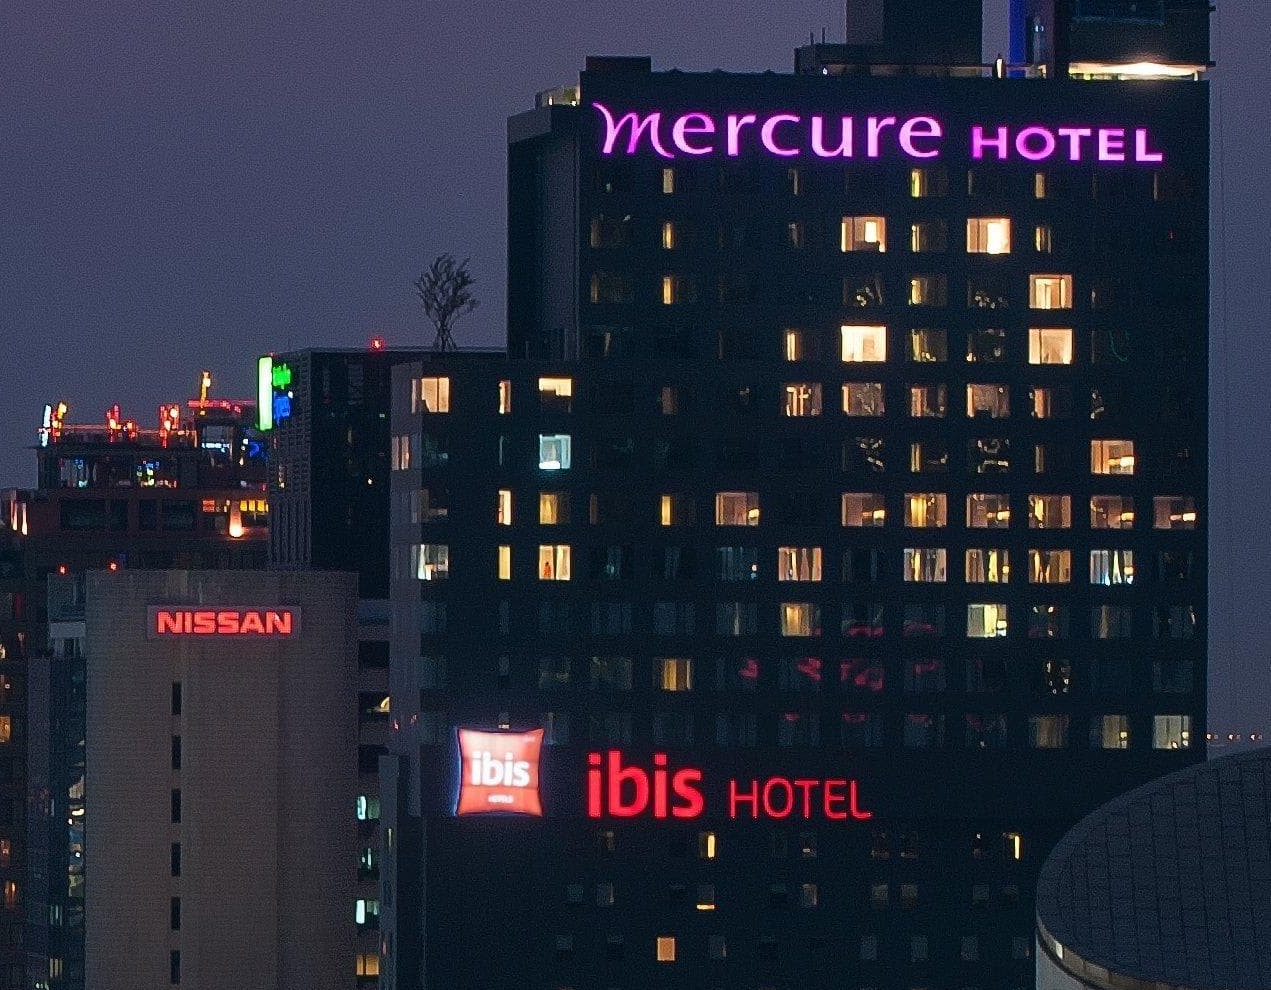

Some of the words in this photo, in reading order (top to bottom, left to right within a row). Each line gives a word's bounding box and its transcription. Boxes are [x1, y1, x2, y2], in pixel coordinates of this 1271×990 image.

[594, 103, 943, 159] mercure
[972, 127, 1164, 161] HOTEL
[157, 611, 292, 634] NISSAN
[471, 750, 530, 787] ibis
[587, 750, 704, 818] ibis
[729, 778, 873, 819] HOTEL
